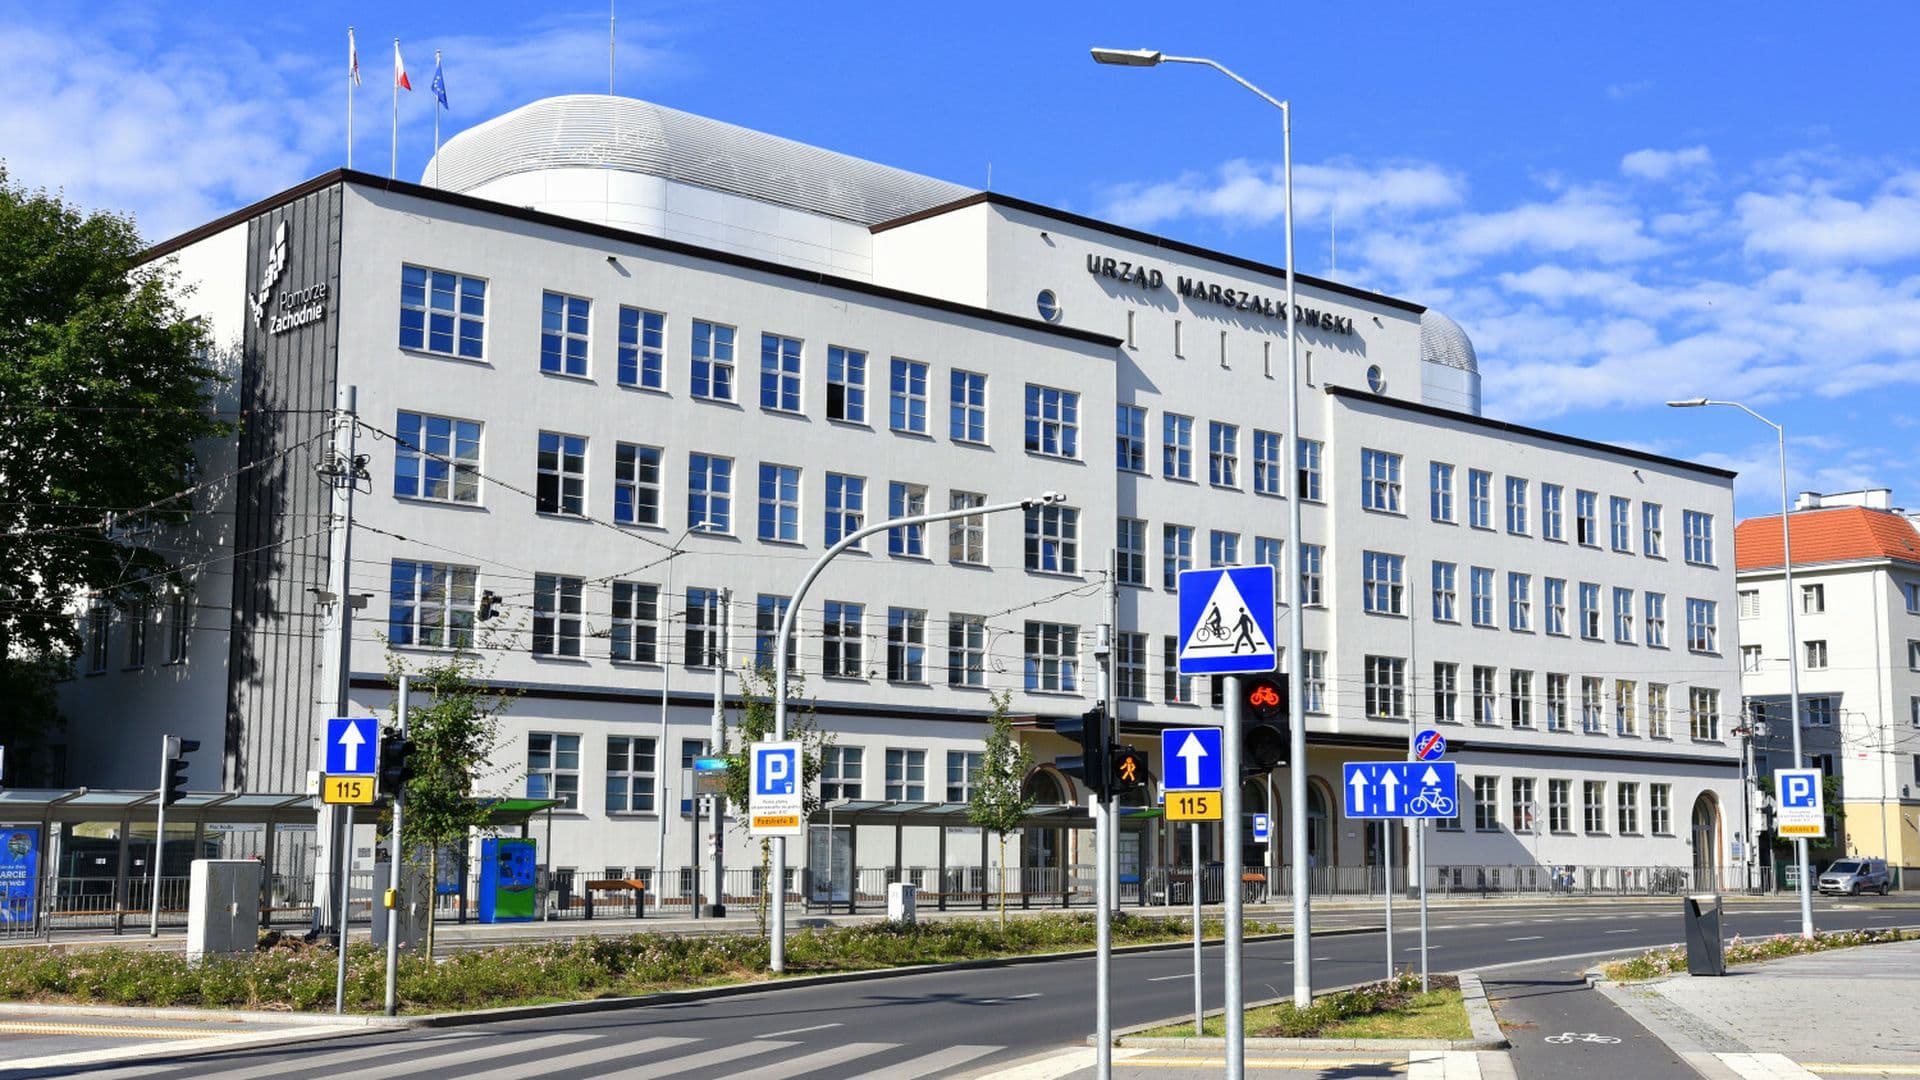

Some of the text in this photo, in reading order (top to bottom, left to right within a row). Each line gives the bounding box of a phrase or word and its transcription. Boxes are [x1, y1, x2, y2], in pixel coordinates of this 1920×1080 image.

[280, 282, 326, 309] Pomorze
[1087, 254, 1353, 335] URZĄD MARSZAŁKOWSKI
[270, 302, 322, 335] Zachodnie
[765, 754, 788, 790] P
[336, 782, 361, 798] 115
[1789, 778, 1809, 804] P
[1179, 797, 1208, 815] 115
